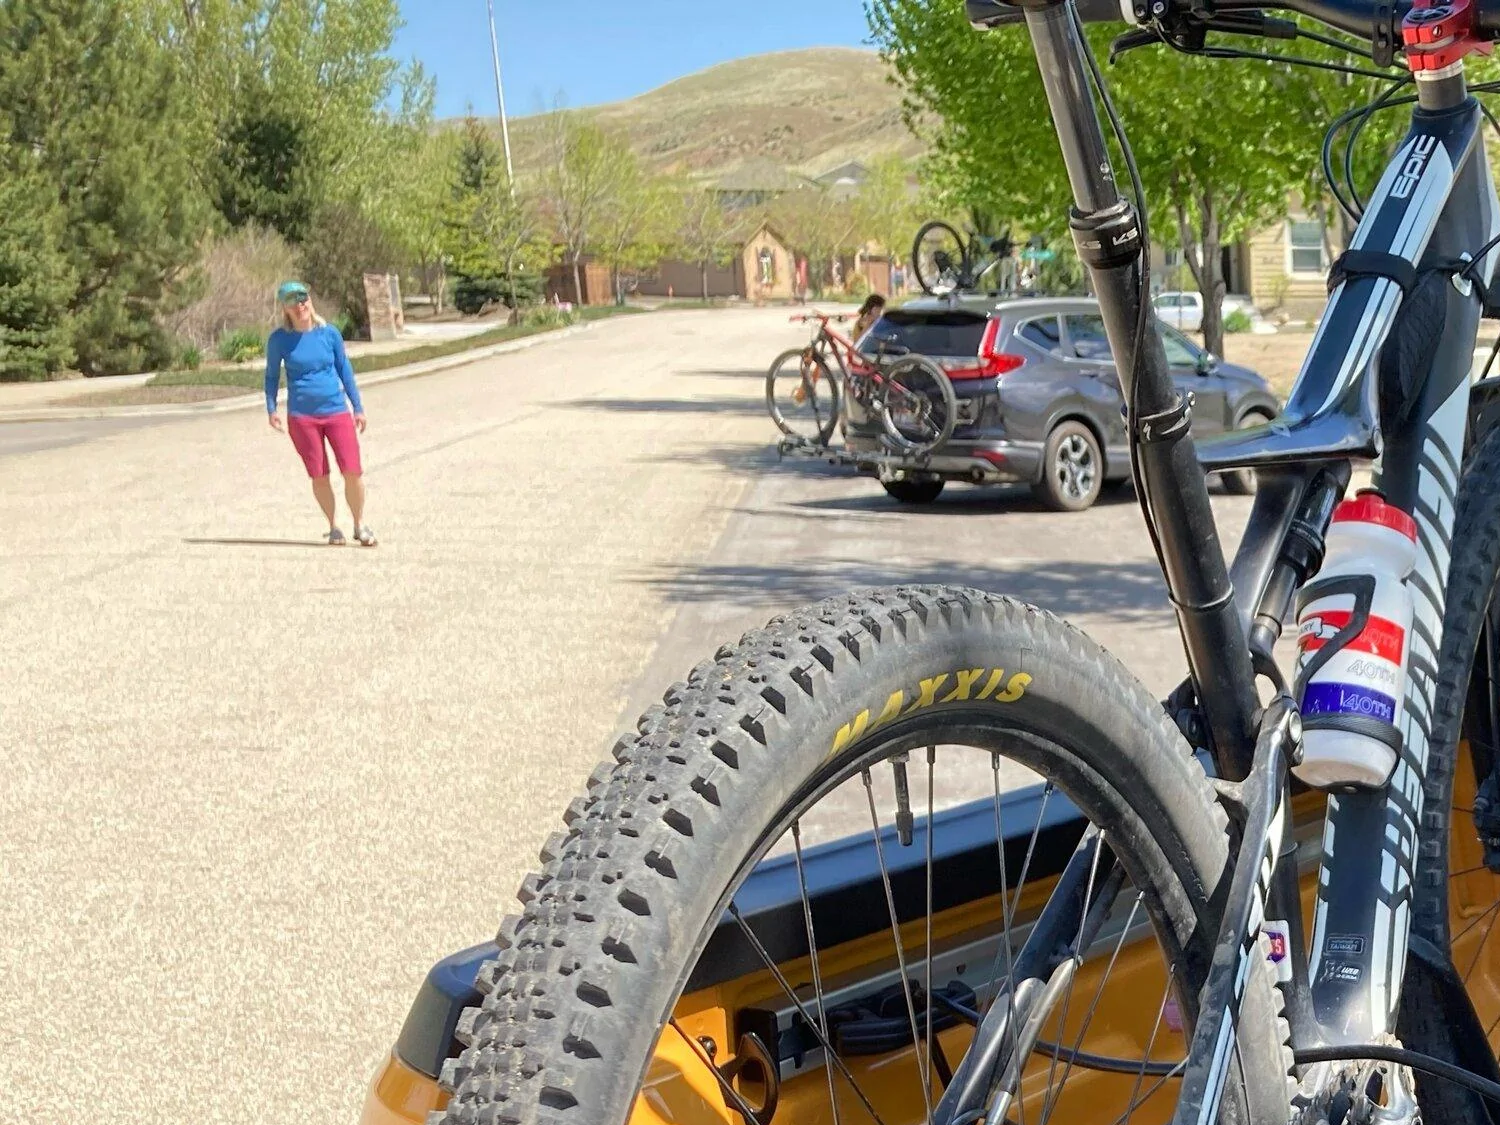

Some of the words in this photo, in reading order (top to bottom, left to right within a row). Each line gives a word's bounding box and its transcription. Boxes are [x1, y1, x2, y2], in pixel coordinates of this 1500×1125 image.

[1389, 134, 1436, 199] EPIC
[822, 667, 1034, 760] MAXXIS
[1342, 693, 1392, 719] 40TH
